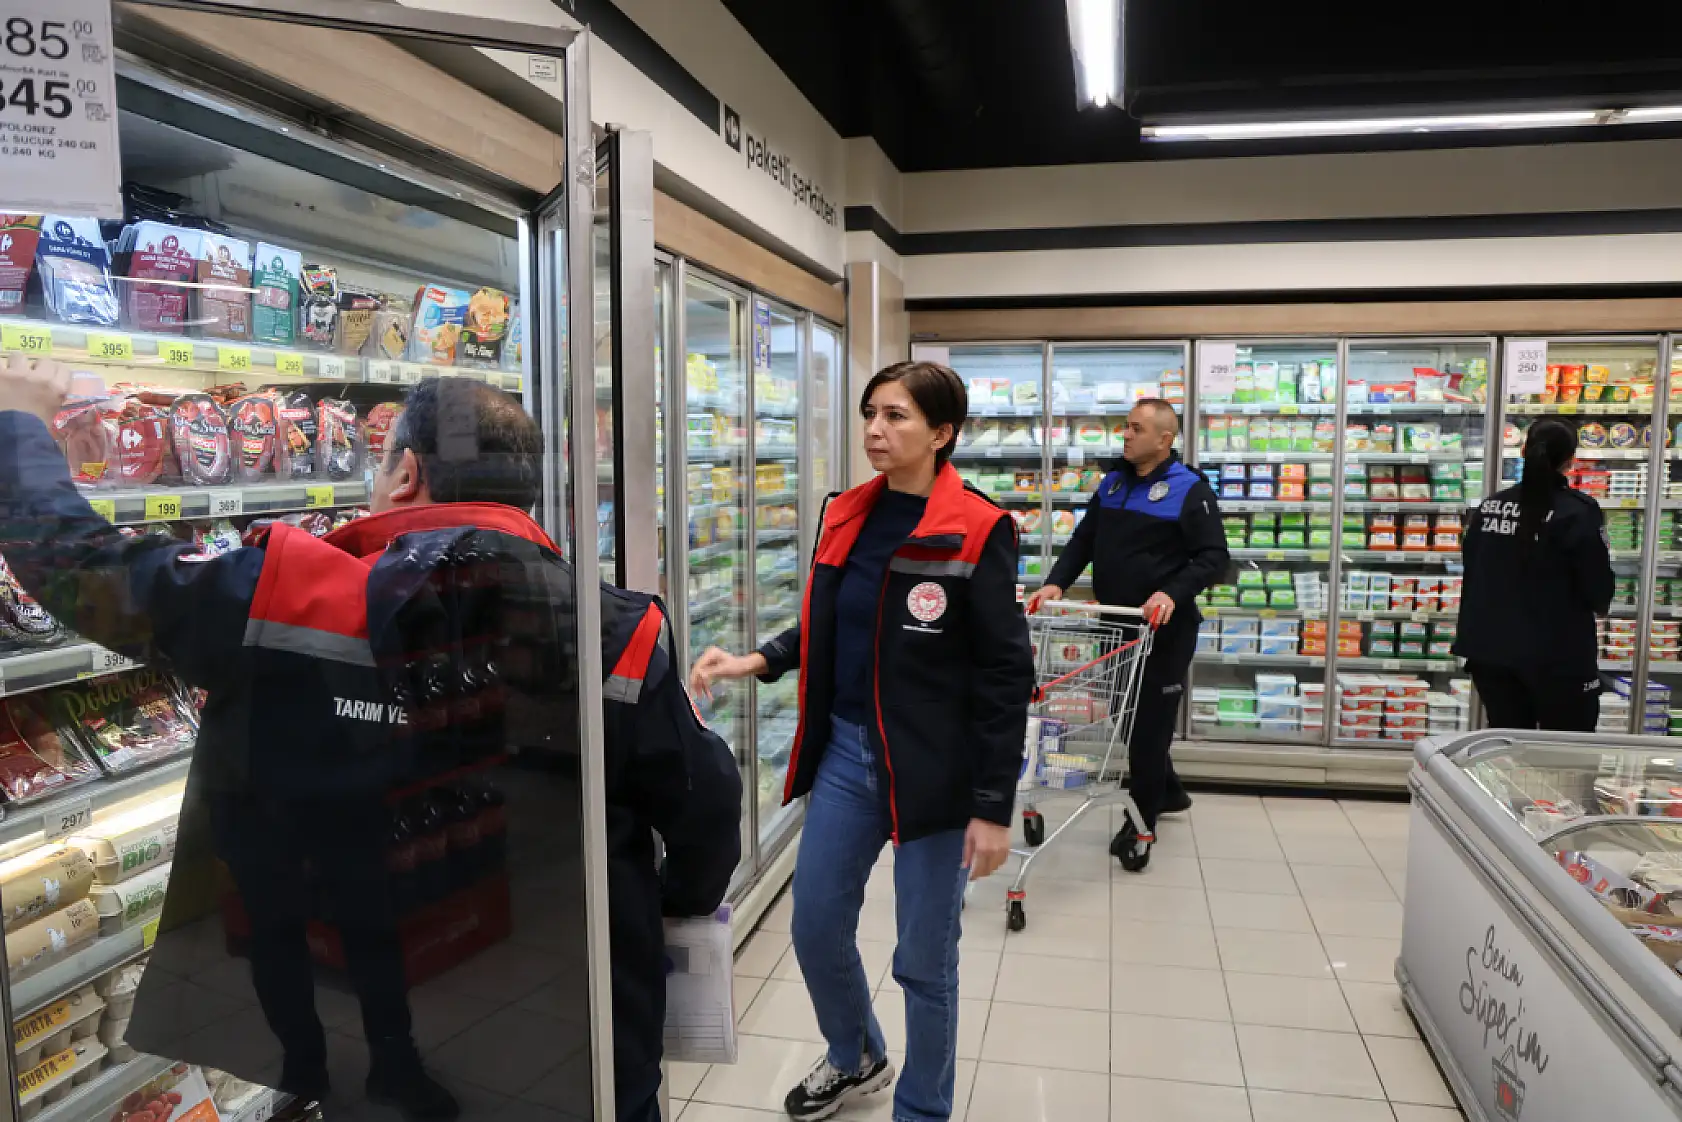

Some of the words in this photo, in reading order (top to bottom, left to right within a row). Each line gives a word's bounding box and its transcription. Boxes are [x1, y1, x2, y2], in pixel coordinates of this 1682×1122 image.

[0, 16, 69, 60] 85
[0, 78, 72, 118] 45
[12, 134, 53, 147] SUCUK
[58, 139, 77, 149] 240
[80, 141, 97, 150] GR
[38, 149, 56, 159] KG
[745, 132, 791, 191] paketli
[792, 171, 838, 227] şarküteri
[20, 334, 43, 349] 357
[102, 343, 124, 356] 395
[169, 349, 189, 362] 395
[157, 502, 176, 515] 199
[1481, 517, 1520, 536] ZABI
[333, 696, 383, 722] TARIM
[387, 701, 408, 724] VE
[62, 810, 84, 830] 297
[1482, 923, 1524, 987] Benim
